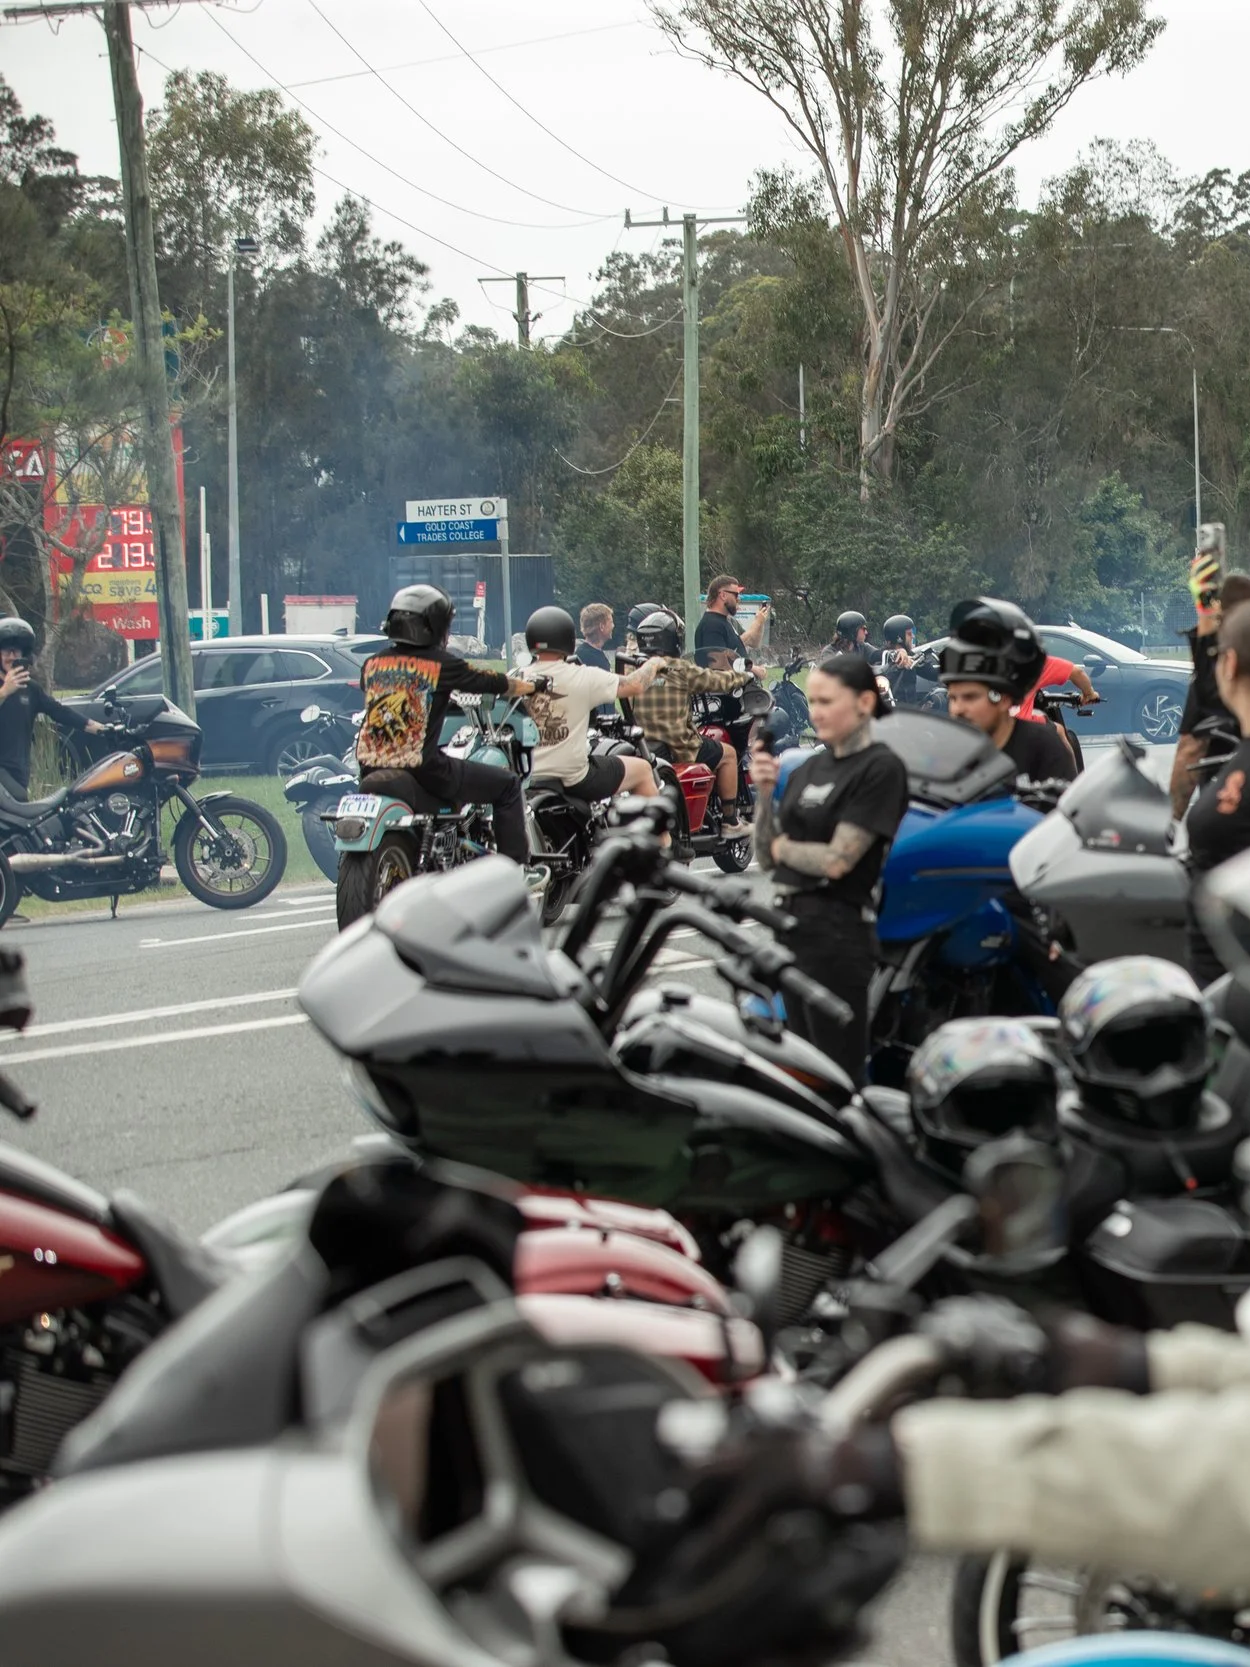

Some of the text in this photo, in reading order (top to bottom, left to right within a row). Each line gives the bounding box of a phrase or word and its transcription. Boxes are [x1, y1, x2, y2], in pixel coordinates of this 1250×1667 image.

[417, 503, 473, 516] HAYTER ST
[425, 521, 474, 531] GOLD COAST
[416, 530, 485, 542] TRADES COLLEGE
[109, 585, 141, 597] save
[112, 616, 151, 630] Wash
